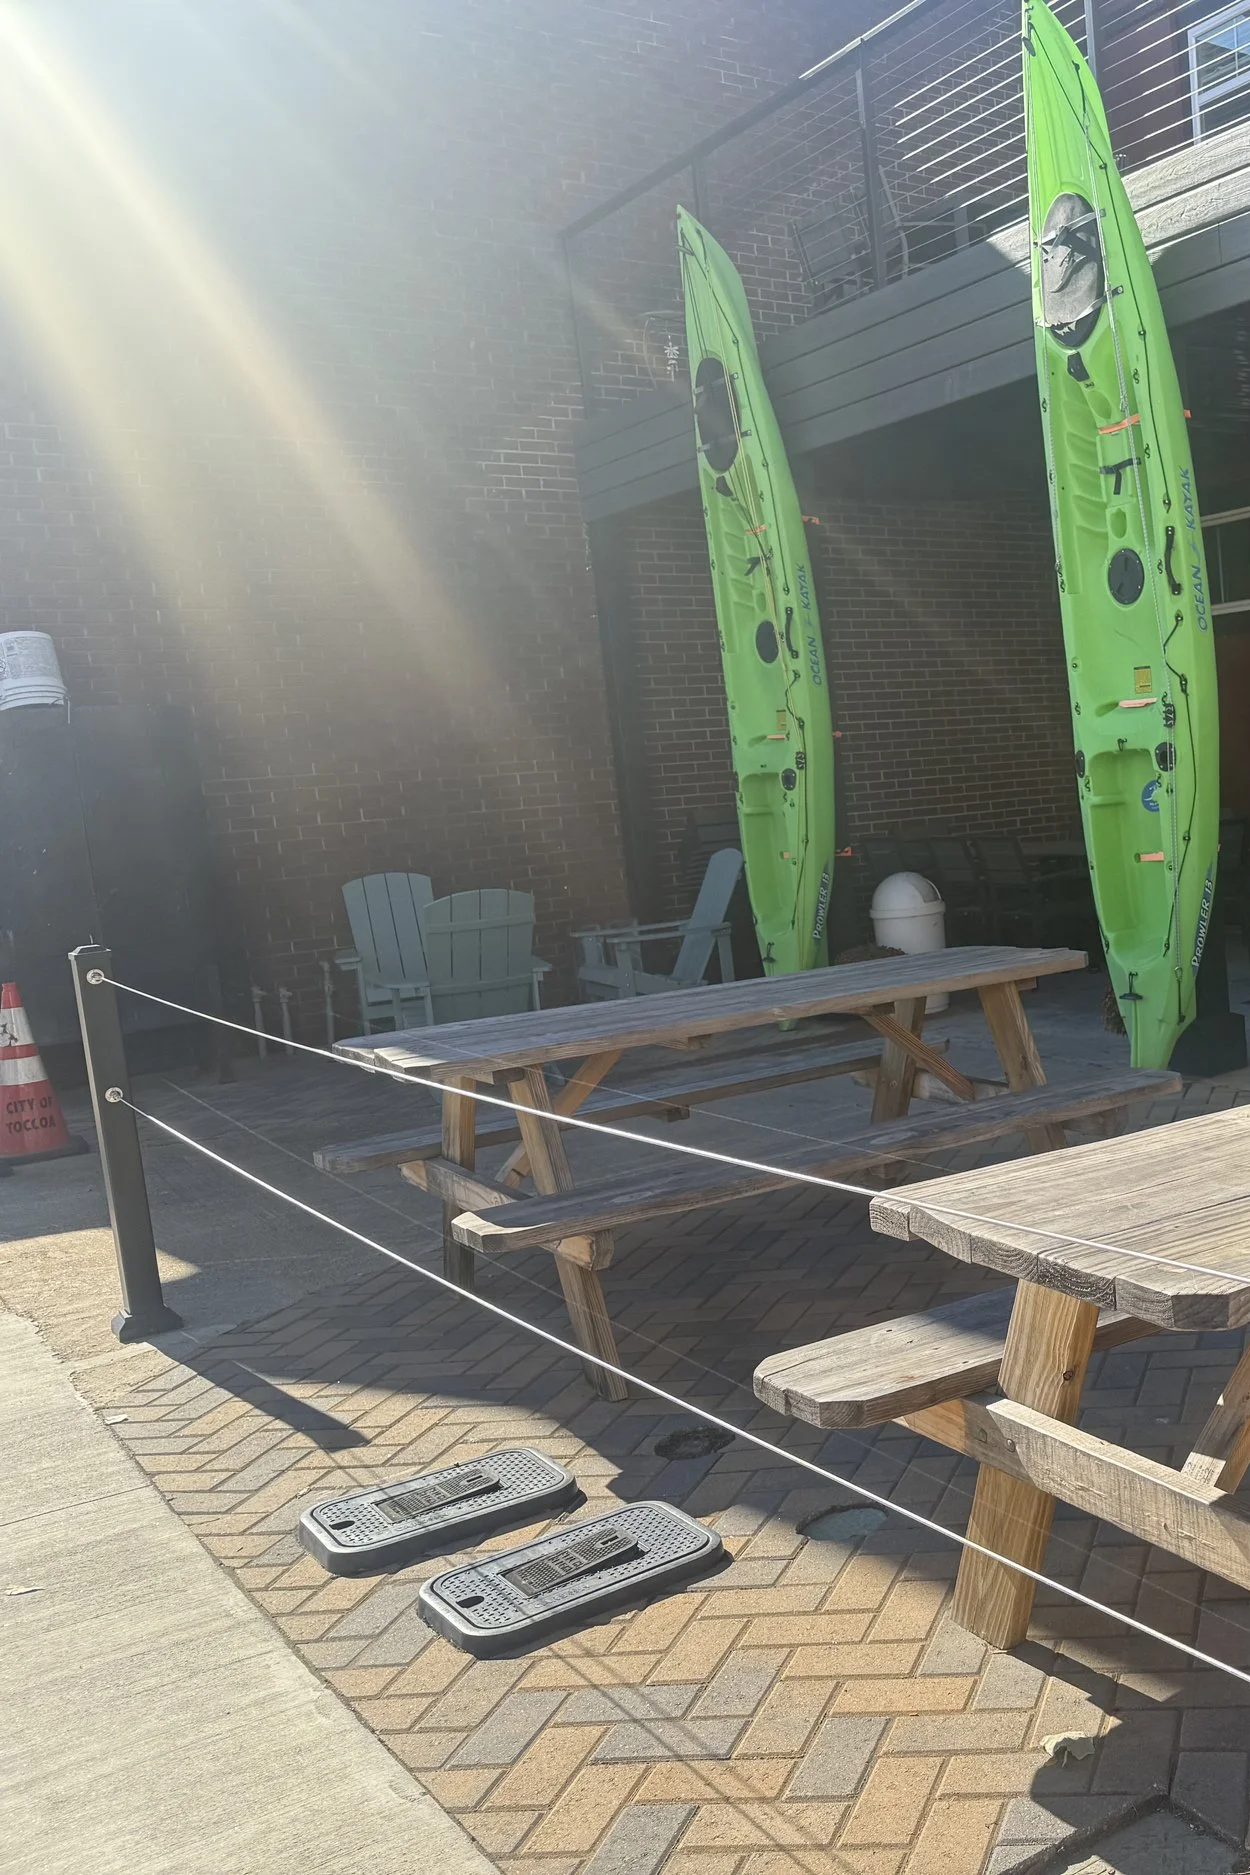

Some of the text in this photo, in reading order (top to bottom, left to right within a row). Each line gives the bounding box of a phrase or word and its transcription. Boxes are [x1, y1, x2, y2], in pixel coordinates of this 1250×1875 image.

[1180, 467, 1208, 632] OCEAN KAYAK
[796, 564, 822, 687] OCEAN KAYAK
[813, 872, 830, 940] PROWLER 13
[1191, 879, 1214, 968] PROWLER 13
[6, 1098, 34, 1114] CITY
